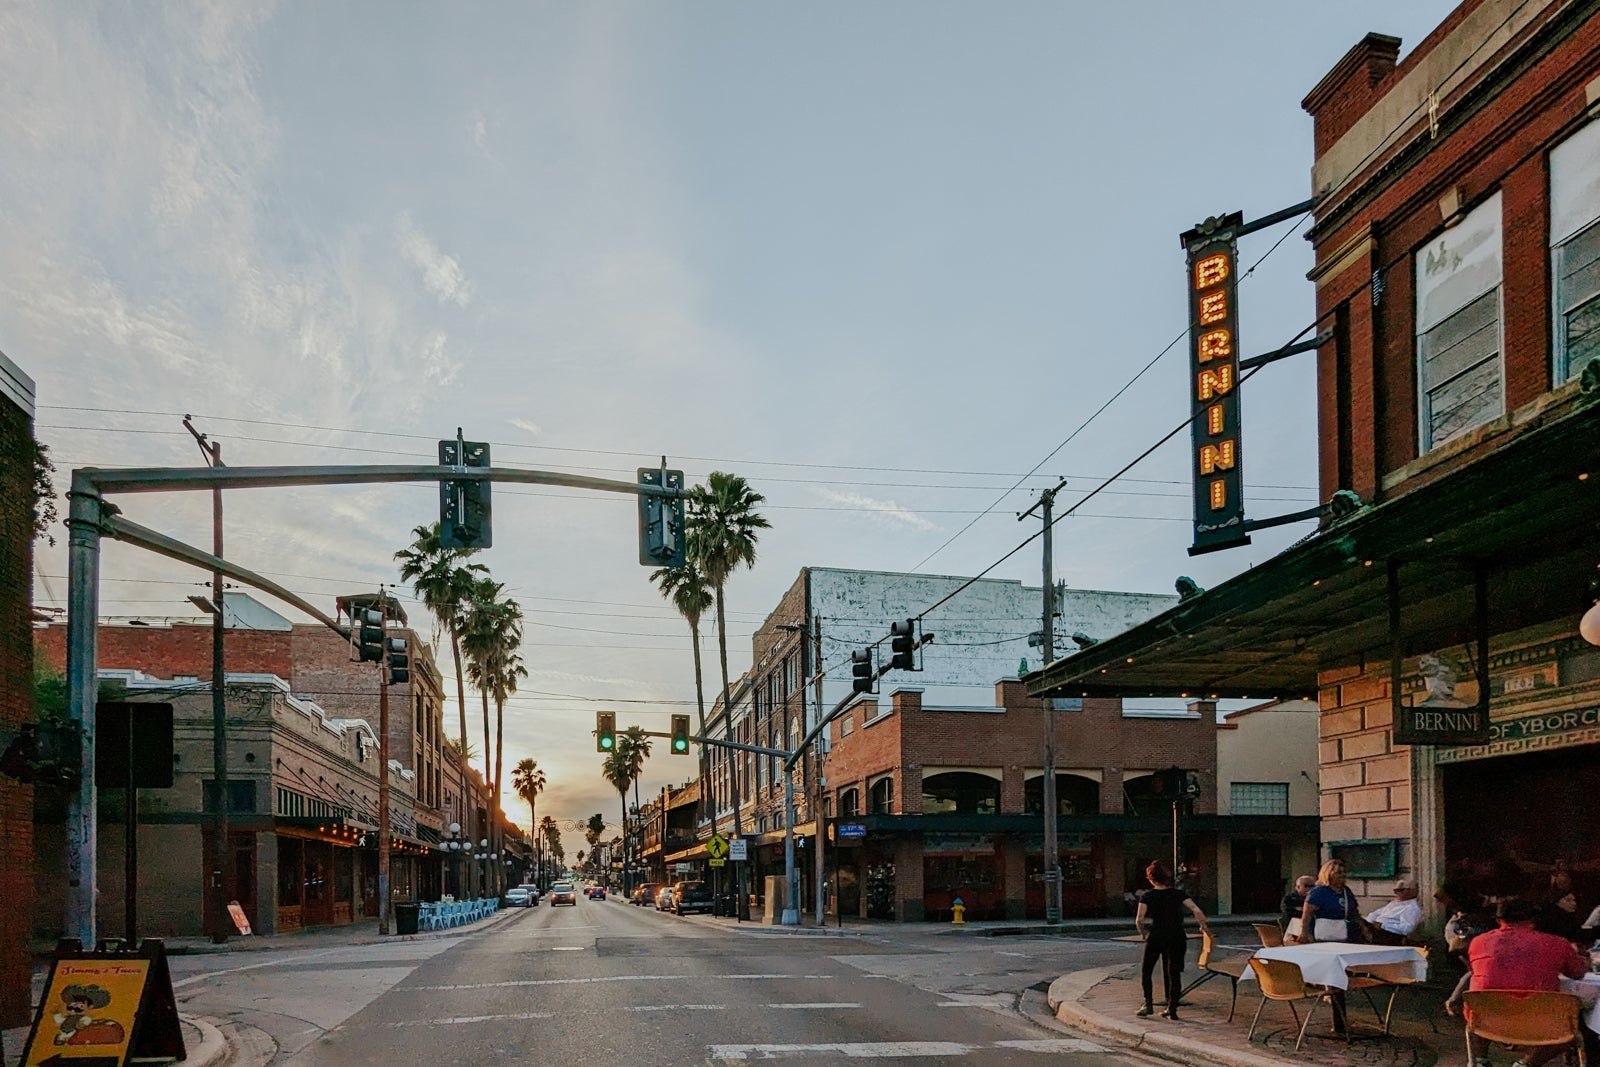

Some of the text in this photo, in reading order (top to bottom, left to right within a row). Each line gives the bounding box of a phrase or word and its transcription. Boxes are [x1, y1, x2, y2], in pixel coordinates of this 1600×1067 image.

[1195, 253, 1234, 511] BERNINI
[1415, 712, 1479, 731] BERNINI
[1518, 712, 1578, 734] YBOR
